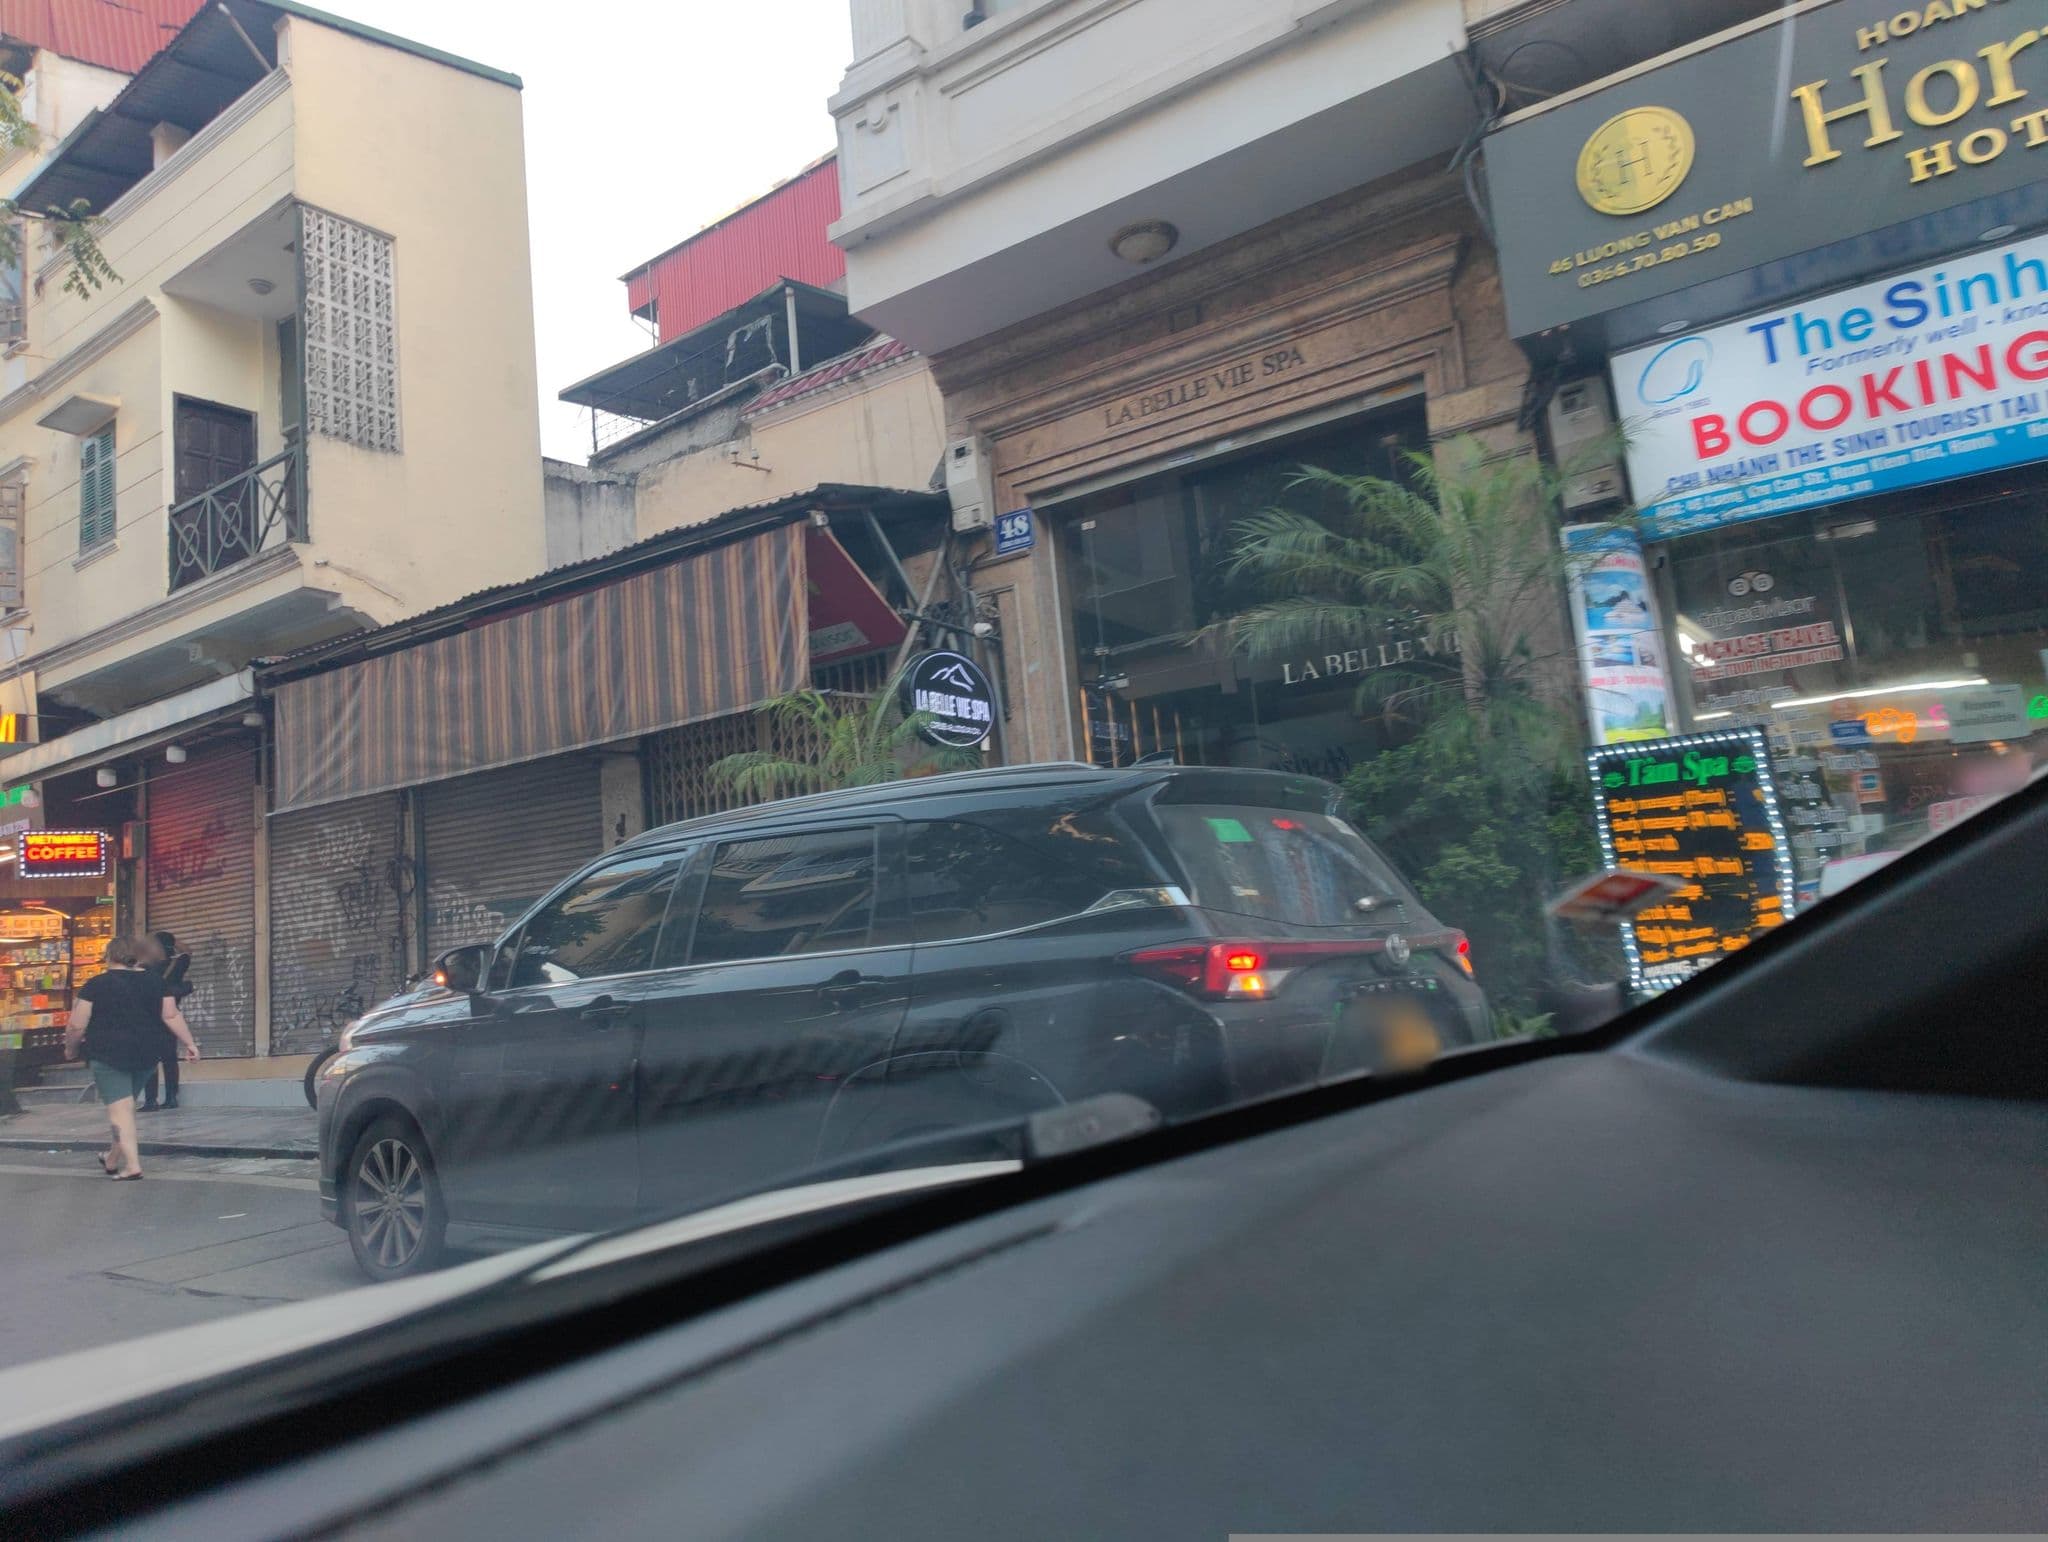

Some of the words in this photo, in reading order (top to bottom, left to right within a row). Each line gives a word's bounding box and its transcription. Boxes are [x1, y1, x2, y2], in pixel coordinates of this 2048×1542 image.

[1790, 25, 2048, 168] Hor
[1575, 231, 1650, 267] LUONG
[1653, 213, 1700, 241] VAN
[1702, 196, 1754, 225] CAN
[1746, 307, 1875, 365] The
[1884, 251, 2048, 329] Sinh
[1806, 336, 1918, 376] Formerly
[1927, 316, 1979, 343] well
[1104, 401, 1134, 428] LA
[1138, 377, 1209, 417] BELLE
[1210, 362, 1255, 390] VIE
[1262, 346, 1306, 377] SPA
[1690, 329, 2048, 461] BOOKING
[1785, 442, 1826, 468] THE
[1833, 428, 1888, 457] SINH
[1895, 404, 1992, 443] TOURIST
[1000, 515, 1029, 539] 48
[1282, 660, 1320, 685] LA
[1324, 640, 1415, 677] BELLE
[915, 689, 928, 711] LA
[928, 691, 957, 716] BELLE
[956, 696, 972, 719] VIE
[971, 700, 990, 722] SPA
[1682, 751, 1730, 786] Spa
[25, 834, 98, 845] VIETNAMESE
[27, 846, 98, 860] COFFEE
